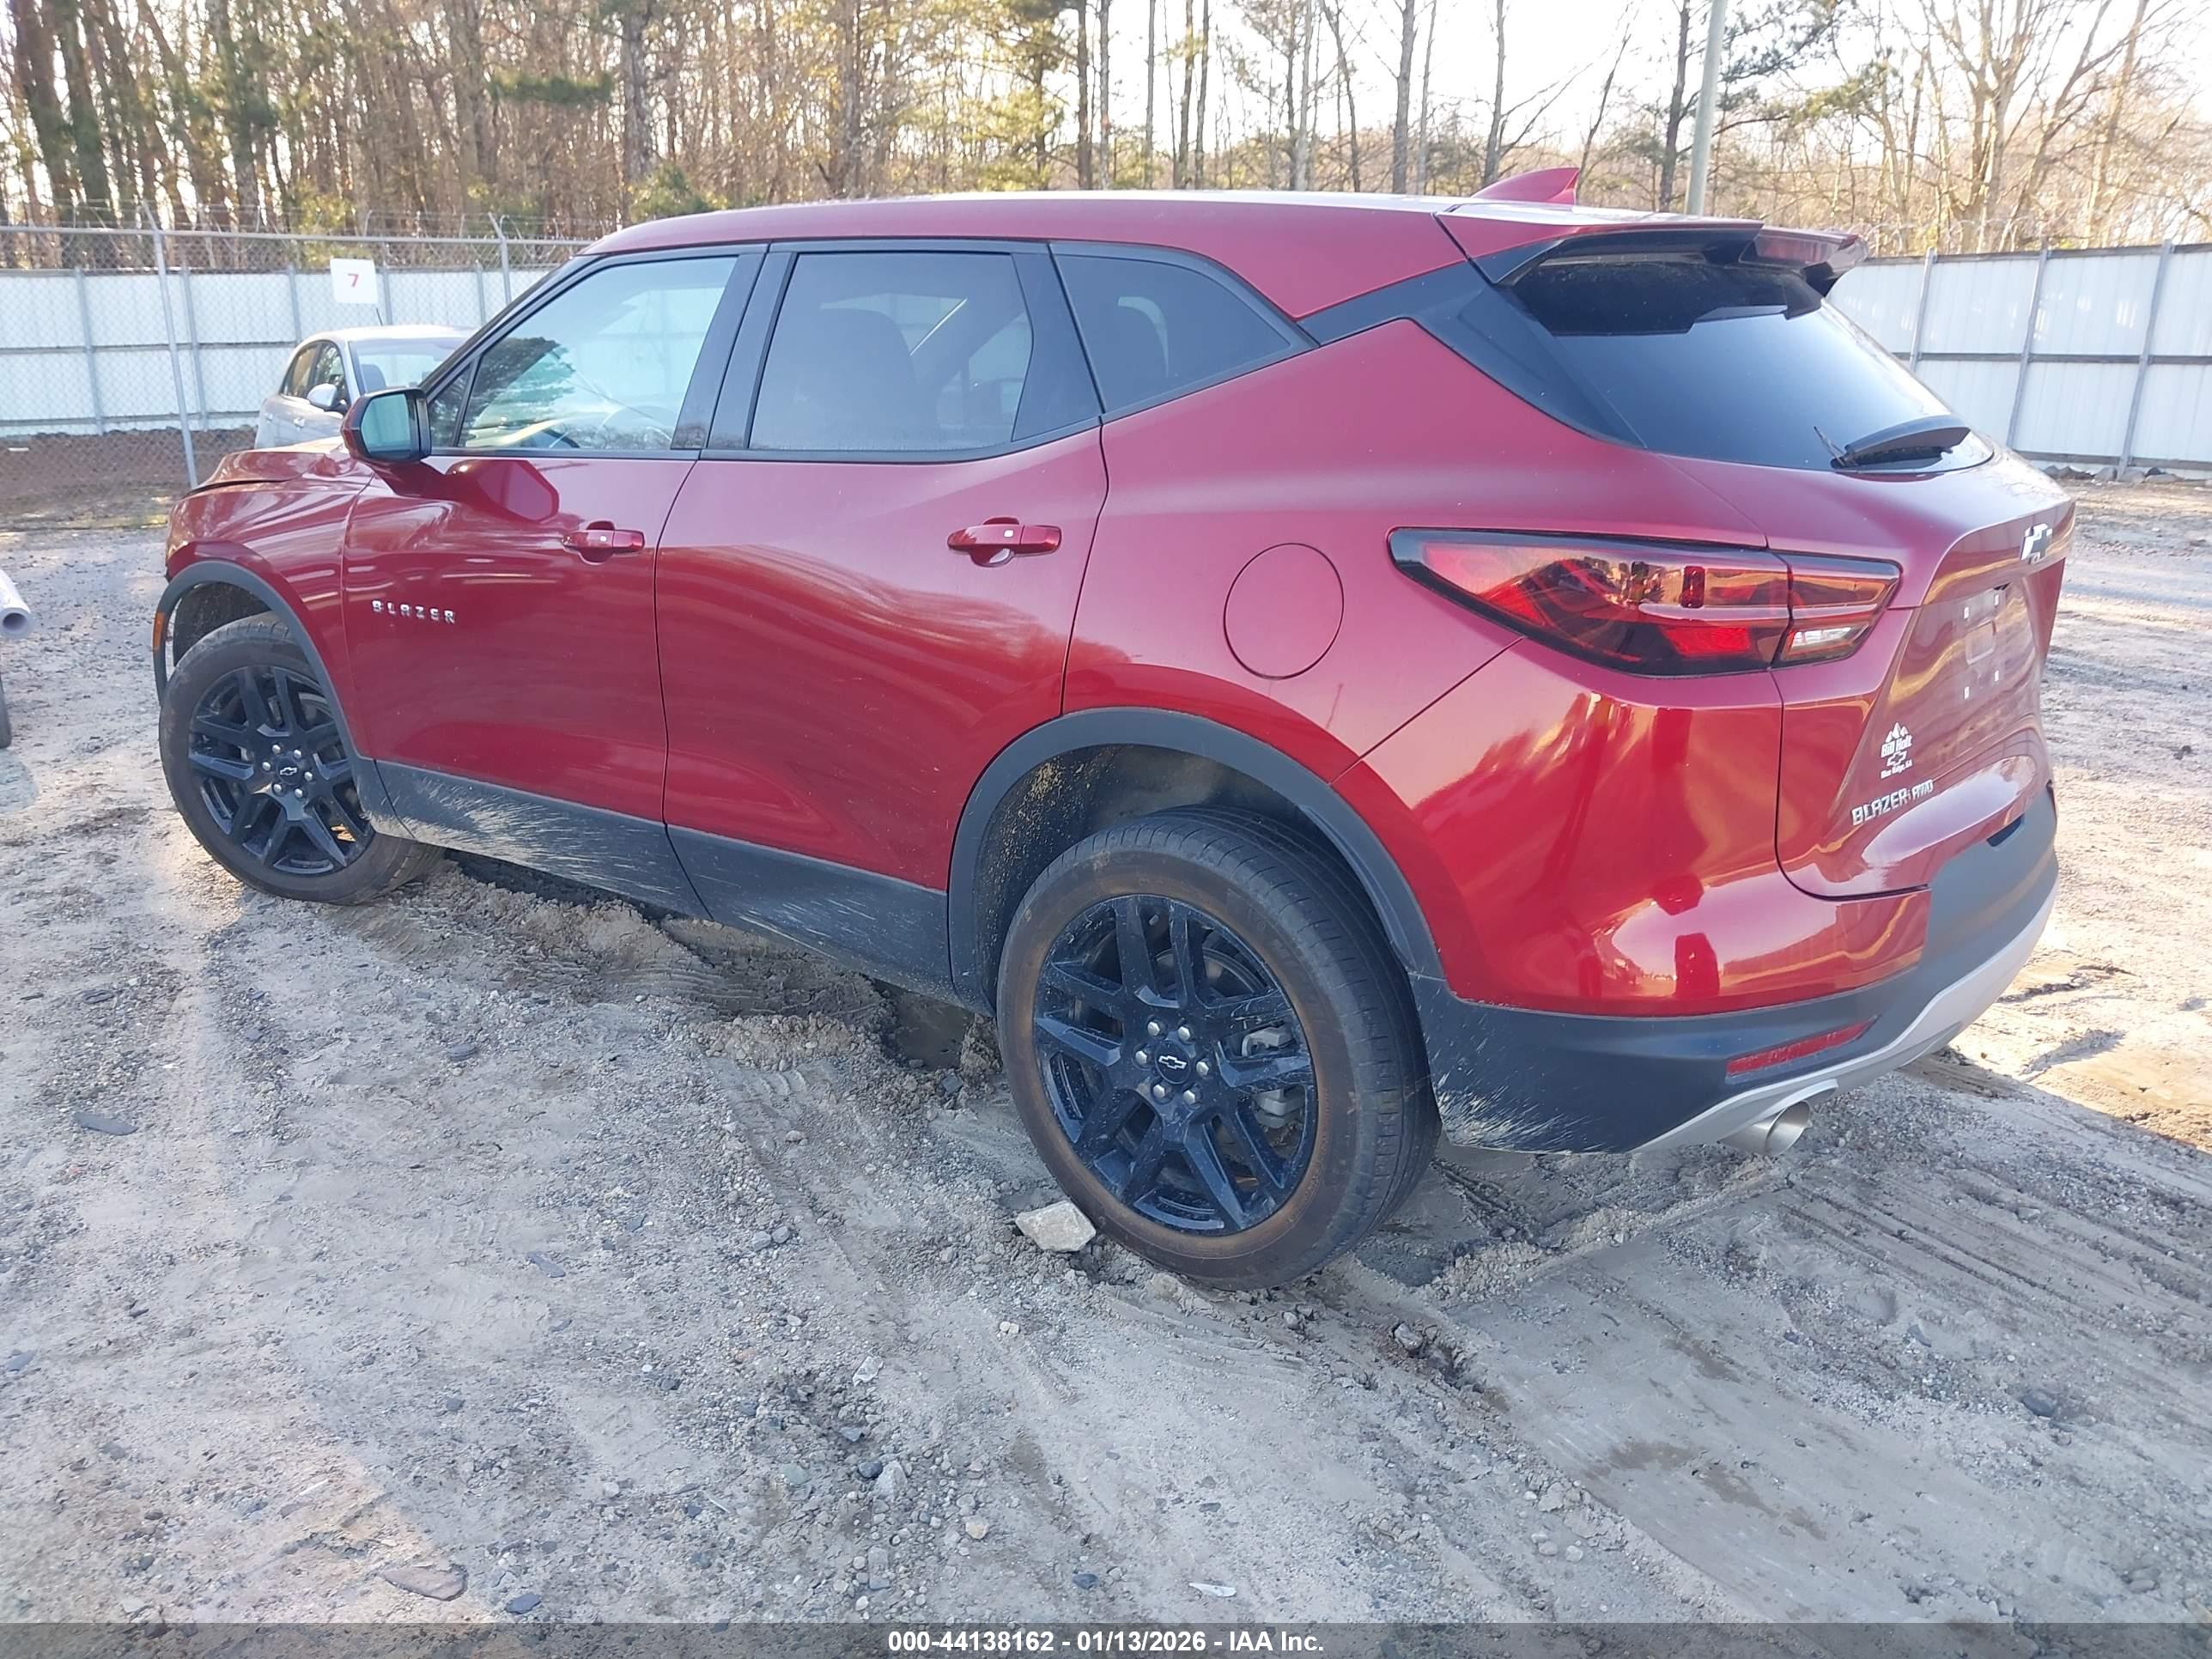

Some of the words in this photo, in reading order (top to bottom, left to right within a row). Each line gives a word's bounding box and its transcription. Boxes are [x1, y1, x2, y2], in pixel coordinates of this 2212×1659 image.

[348, 273, 359, 288] 7
[372, 600, 455, 624] BLAZER
[1851, 788, 1908, 826] BLAZER
